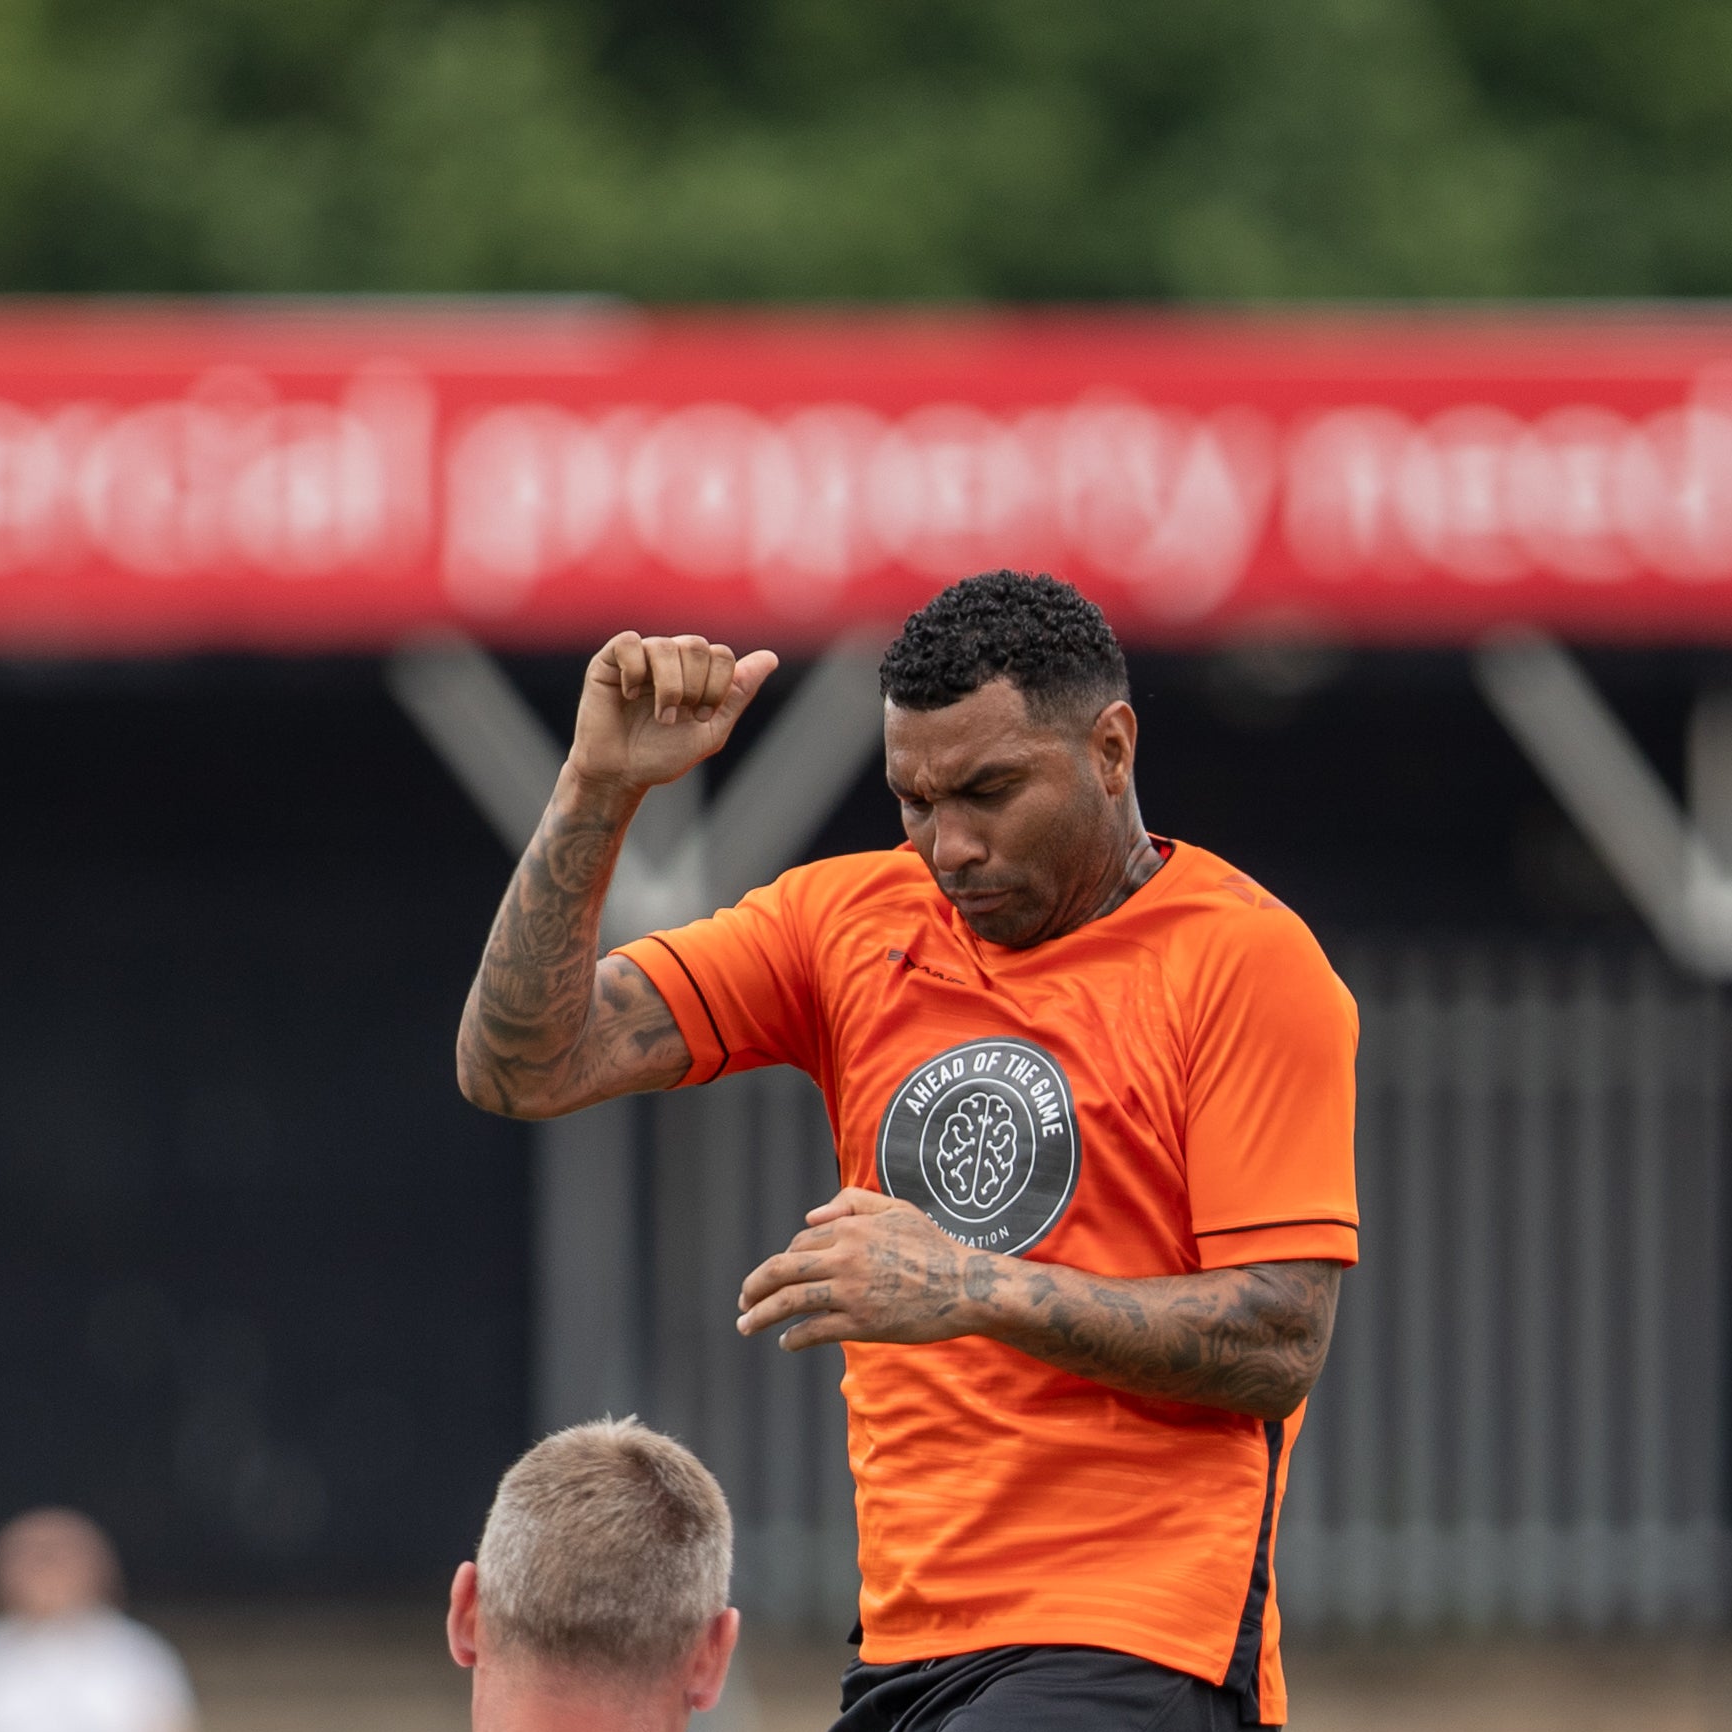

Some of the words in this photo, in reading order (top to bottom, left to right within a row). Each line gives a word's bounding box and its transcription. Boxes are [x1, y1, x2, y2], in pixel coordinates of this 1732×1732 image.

[441, 388, 1267, 620] property
[905, 1057, 965, 1116] AHEAD
[973, 1051, 1002, 1072] OF
[1003, 1053, 1040, 1086] THE
[1029, 1078, 1064, 1138] GAME
